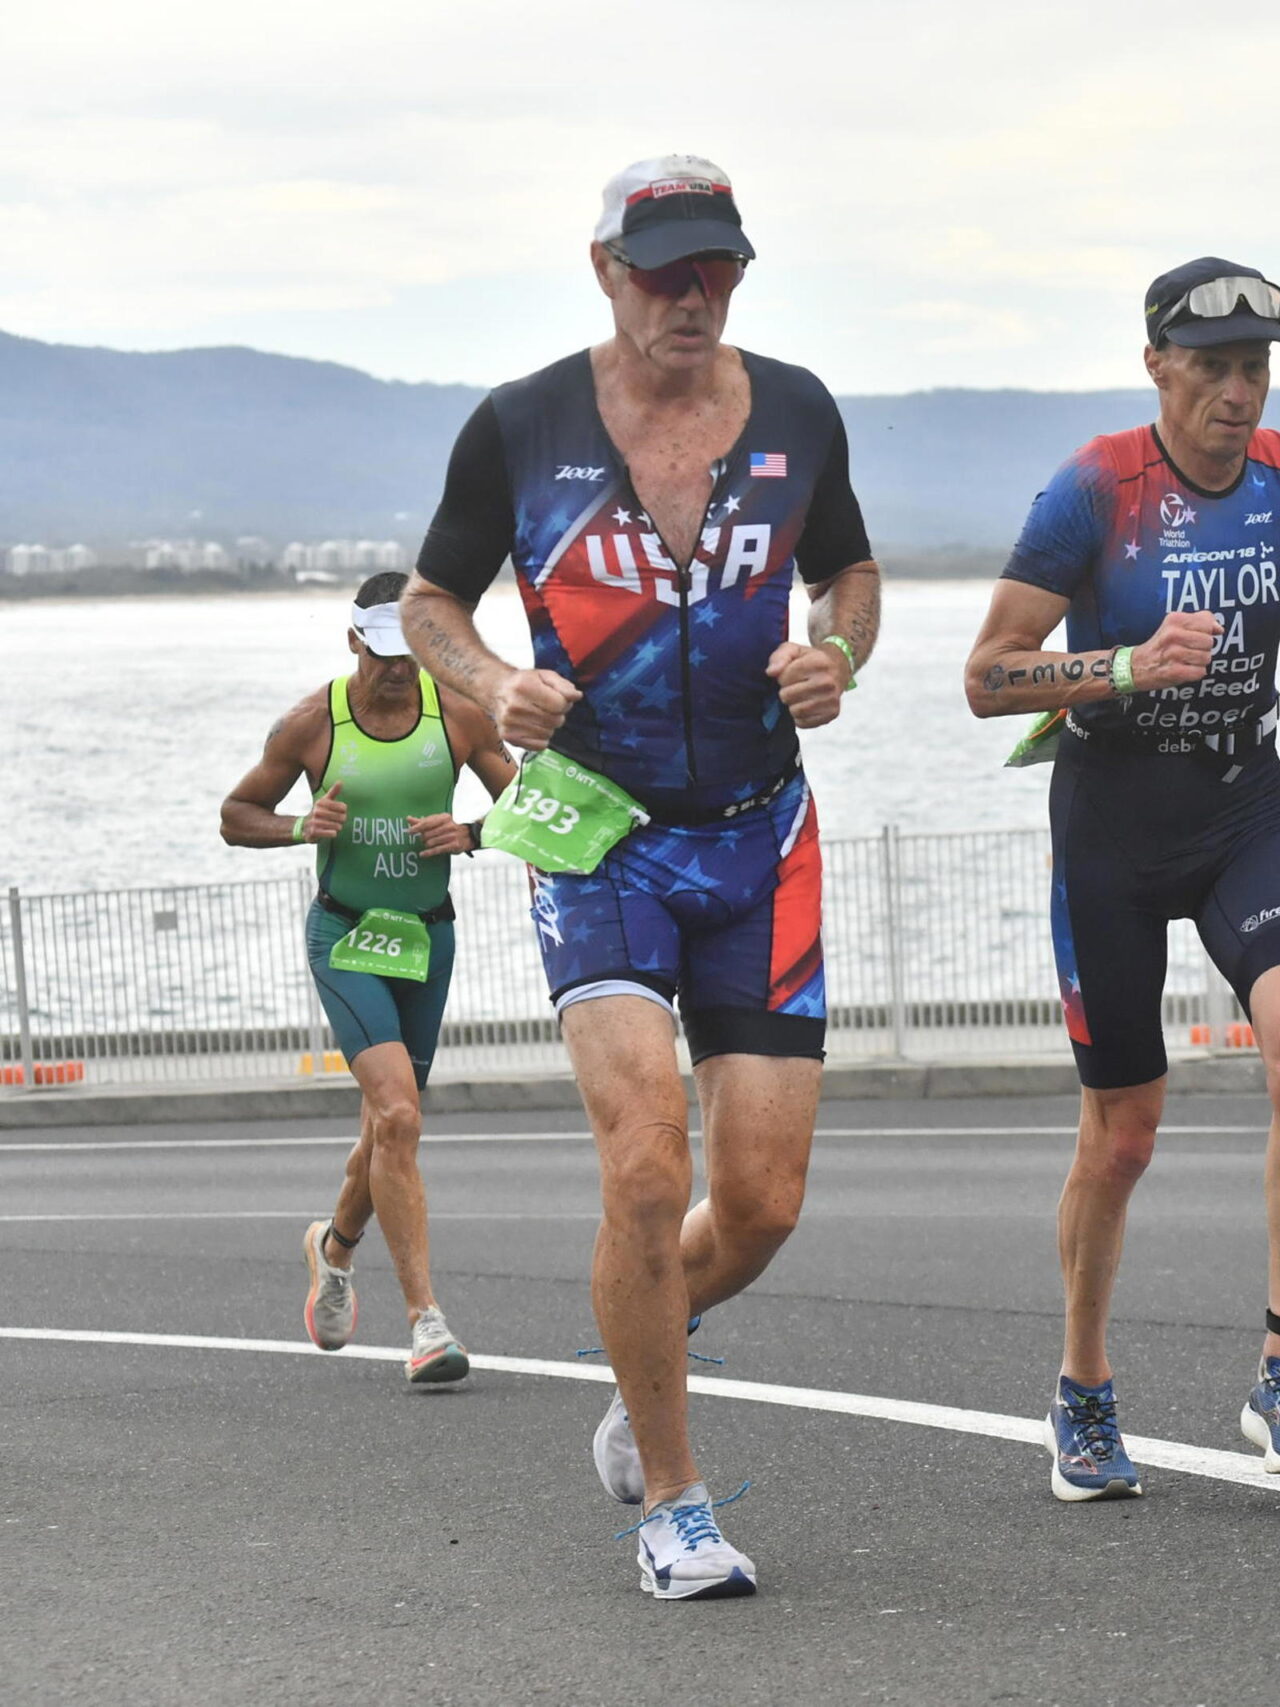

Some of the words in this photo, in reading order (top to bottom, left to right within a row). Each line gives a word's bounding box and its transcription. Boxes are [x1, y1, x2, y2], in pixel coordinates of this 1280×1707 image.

[654, 183, 686, 195] TEAM
[689, 182, 710, 191] USA
[1158, 537, 1191, 548] Triathlon
[1163, 529, 1185, 538] World
[585, 524, 771, 608] USA
[1162, 549, 1235, 563] ARGON
[1236, 547, 1256, 558] 18
[1161, 560, 1280, 613] TAYLOR
[503, 784, 580, 834] 1393
[374, 852, 418, 878] AUS
[347, 928, 403, 957] 1226
